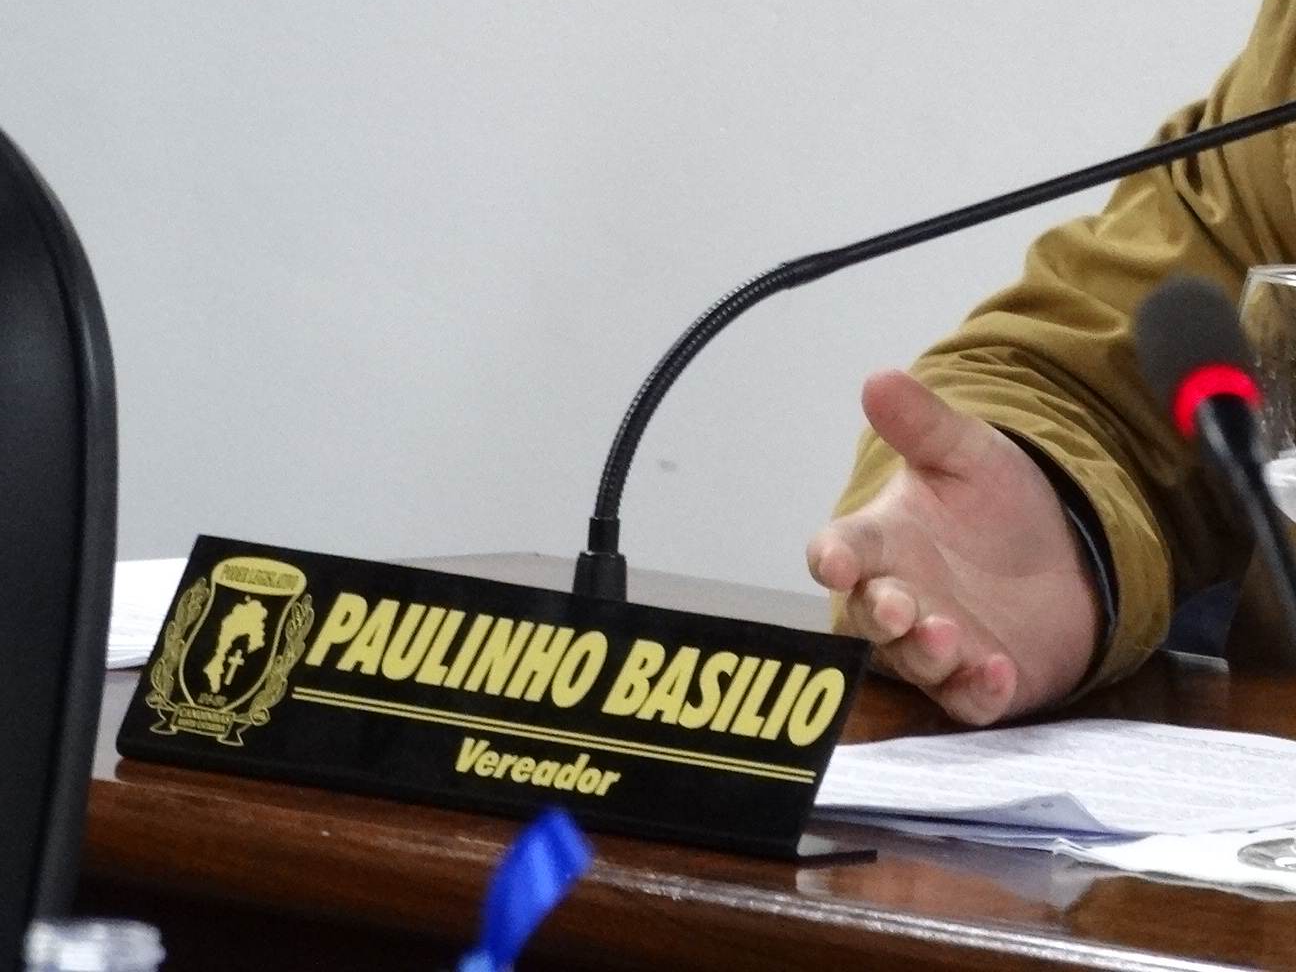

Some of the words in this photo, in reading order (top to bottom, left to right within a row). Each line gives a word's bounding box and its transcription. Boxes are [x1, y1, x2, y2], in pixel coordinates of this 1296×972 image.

[304, 592, 608, 708] PAULINHO
[602, 641, 845, 747] BASILIO
[456, 739, 621, 796] Vereador
